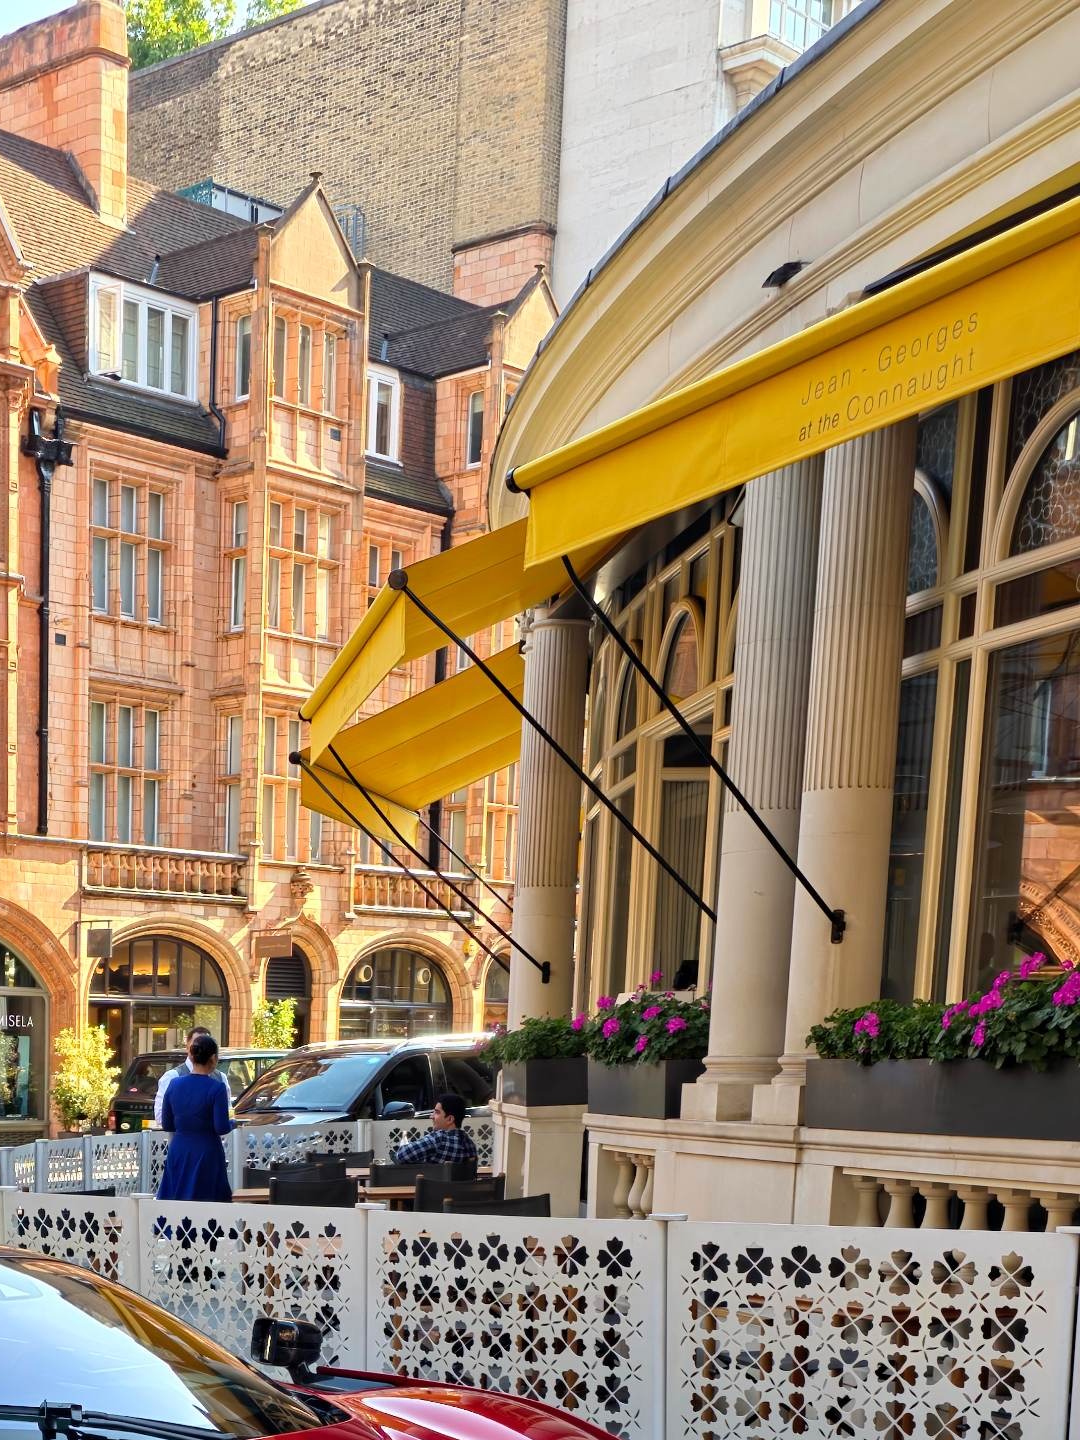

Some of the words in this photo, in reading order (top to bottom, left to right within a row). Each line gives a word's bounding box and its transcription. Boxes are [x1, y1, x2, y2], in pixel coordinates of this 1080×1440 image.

[798, 421, 813, 442] at
[817, 411, 840, 435] the
[846, 348, 976, 421] Connaught
[801, 368, 851, 405] Jean
[878, 312, 978, 371] Georges
